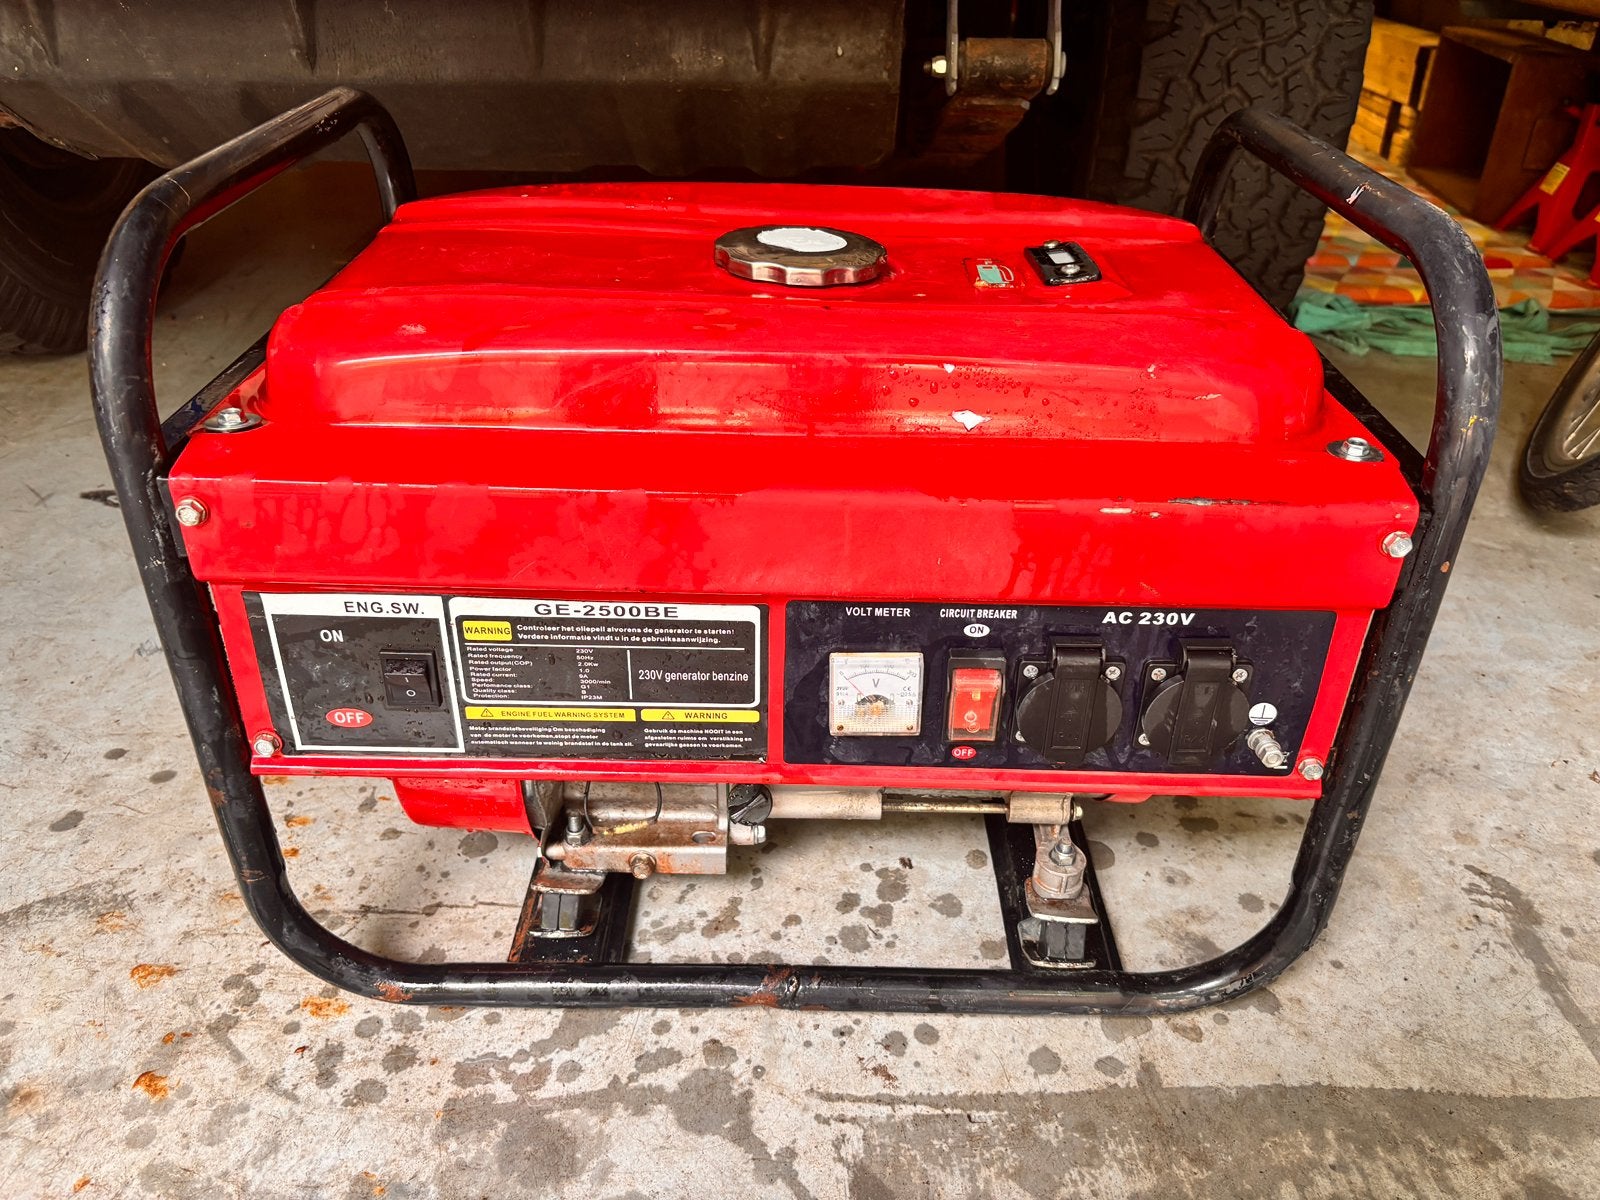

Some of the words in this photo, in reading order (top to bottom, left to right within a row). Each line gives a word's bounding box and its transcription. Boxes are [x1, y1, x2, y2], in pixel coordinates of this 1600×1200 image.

[344, 601, 425, 615] ENG.SW.
[534, 604, 679, 618] GE-2500BE
[846, 607, 872, 617] VOLT
[875, 607, 910, 617] METER
[940, 608, 974, 618] CIRCUIT
[977, 609, 1017, 619] BREAKER
[1102, 612, 1132, 624] AC
[1138, 613, 1196, 626] 230V
[320, 629, 343, 642] ON
[465, 627, 510, 635] WARNING
[969, 626, 984, 634] ON
[639, 670, 663, 679] 230V
[665, 671, 710, 683] generator
[712, 671, 748, 681] benzine
[872, 678, 880, 688] V
[334, 712, 364, 723] OFF
[954, 749, 973, 757] OFF
